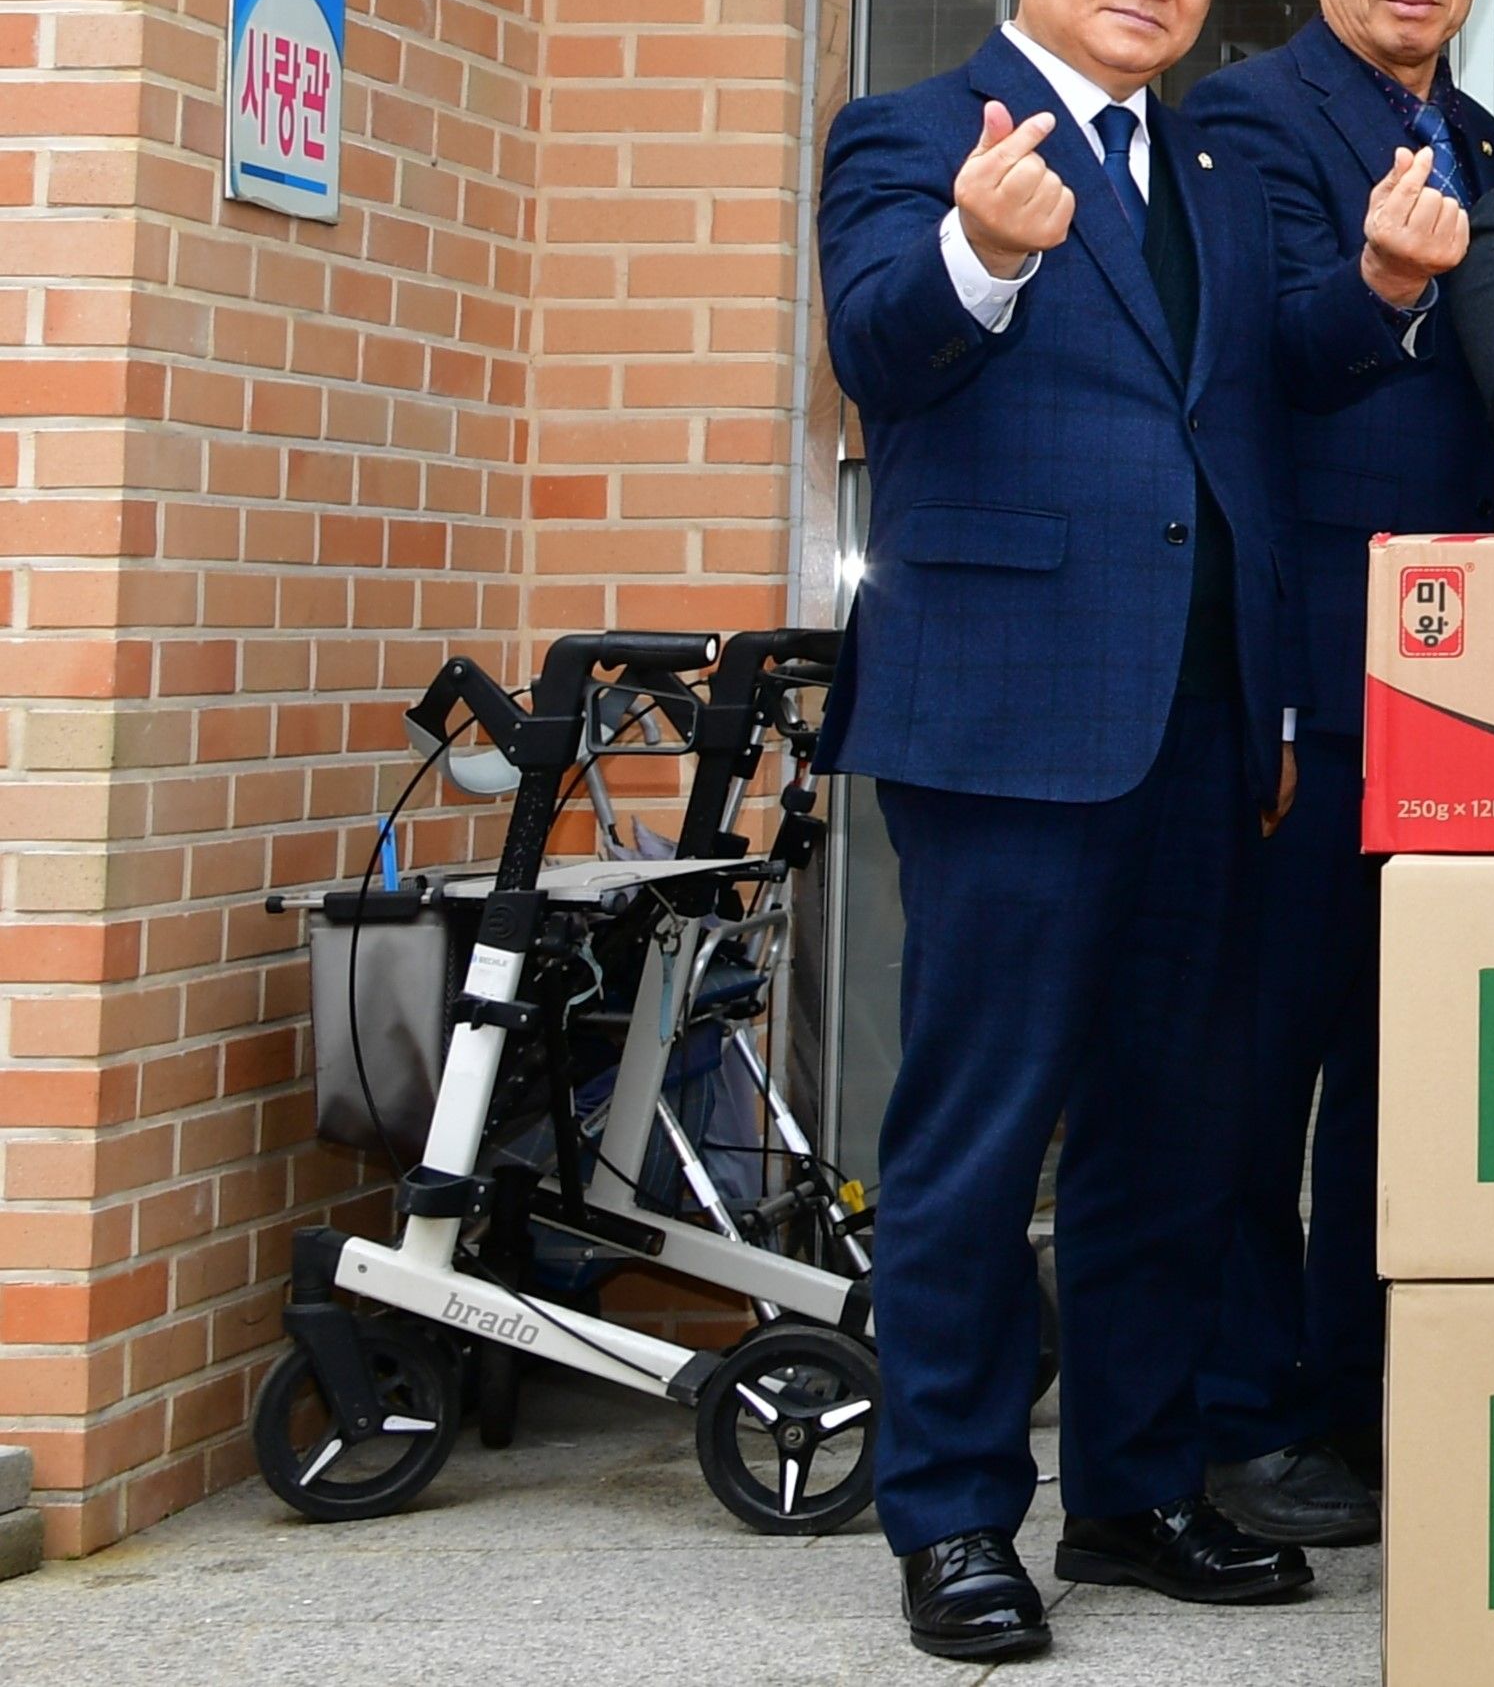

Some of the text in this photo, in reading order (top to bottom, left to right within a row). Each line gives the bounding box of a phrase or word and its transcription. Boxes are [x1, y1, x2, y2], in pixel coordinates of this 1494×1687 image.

[241, 27, 331, 161] 사랑관
[1414, 578, 1449, 648] 미왕
[1398, 801, 1449, 822] 250g
[441, 1291, 540, 1345] brado
